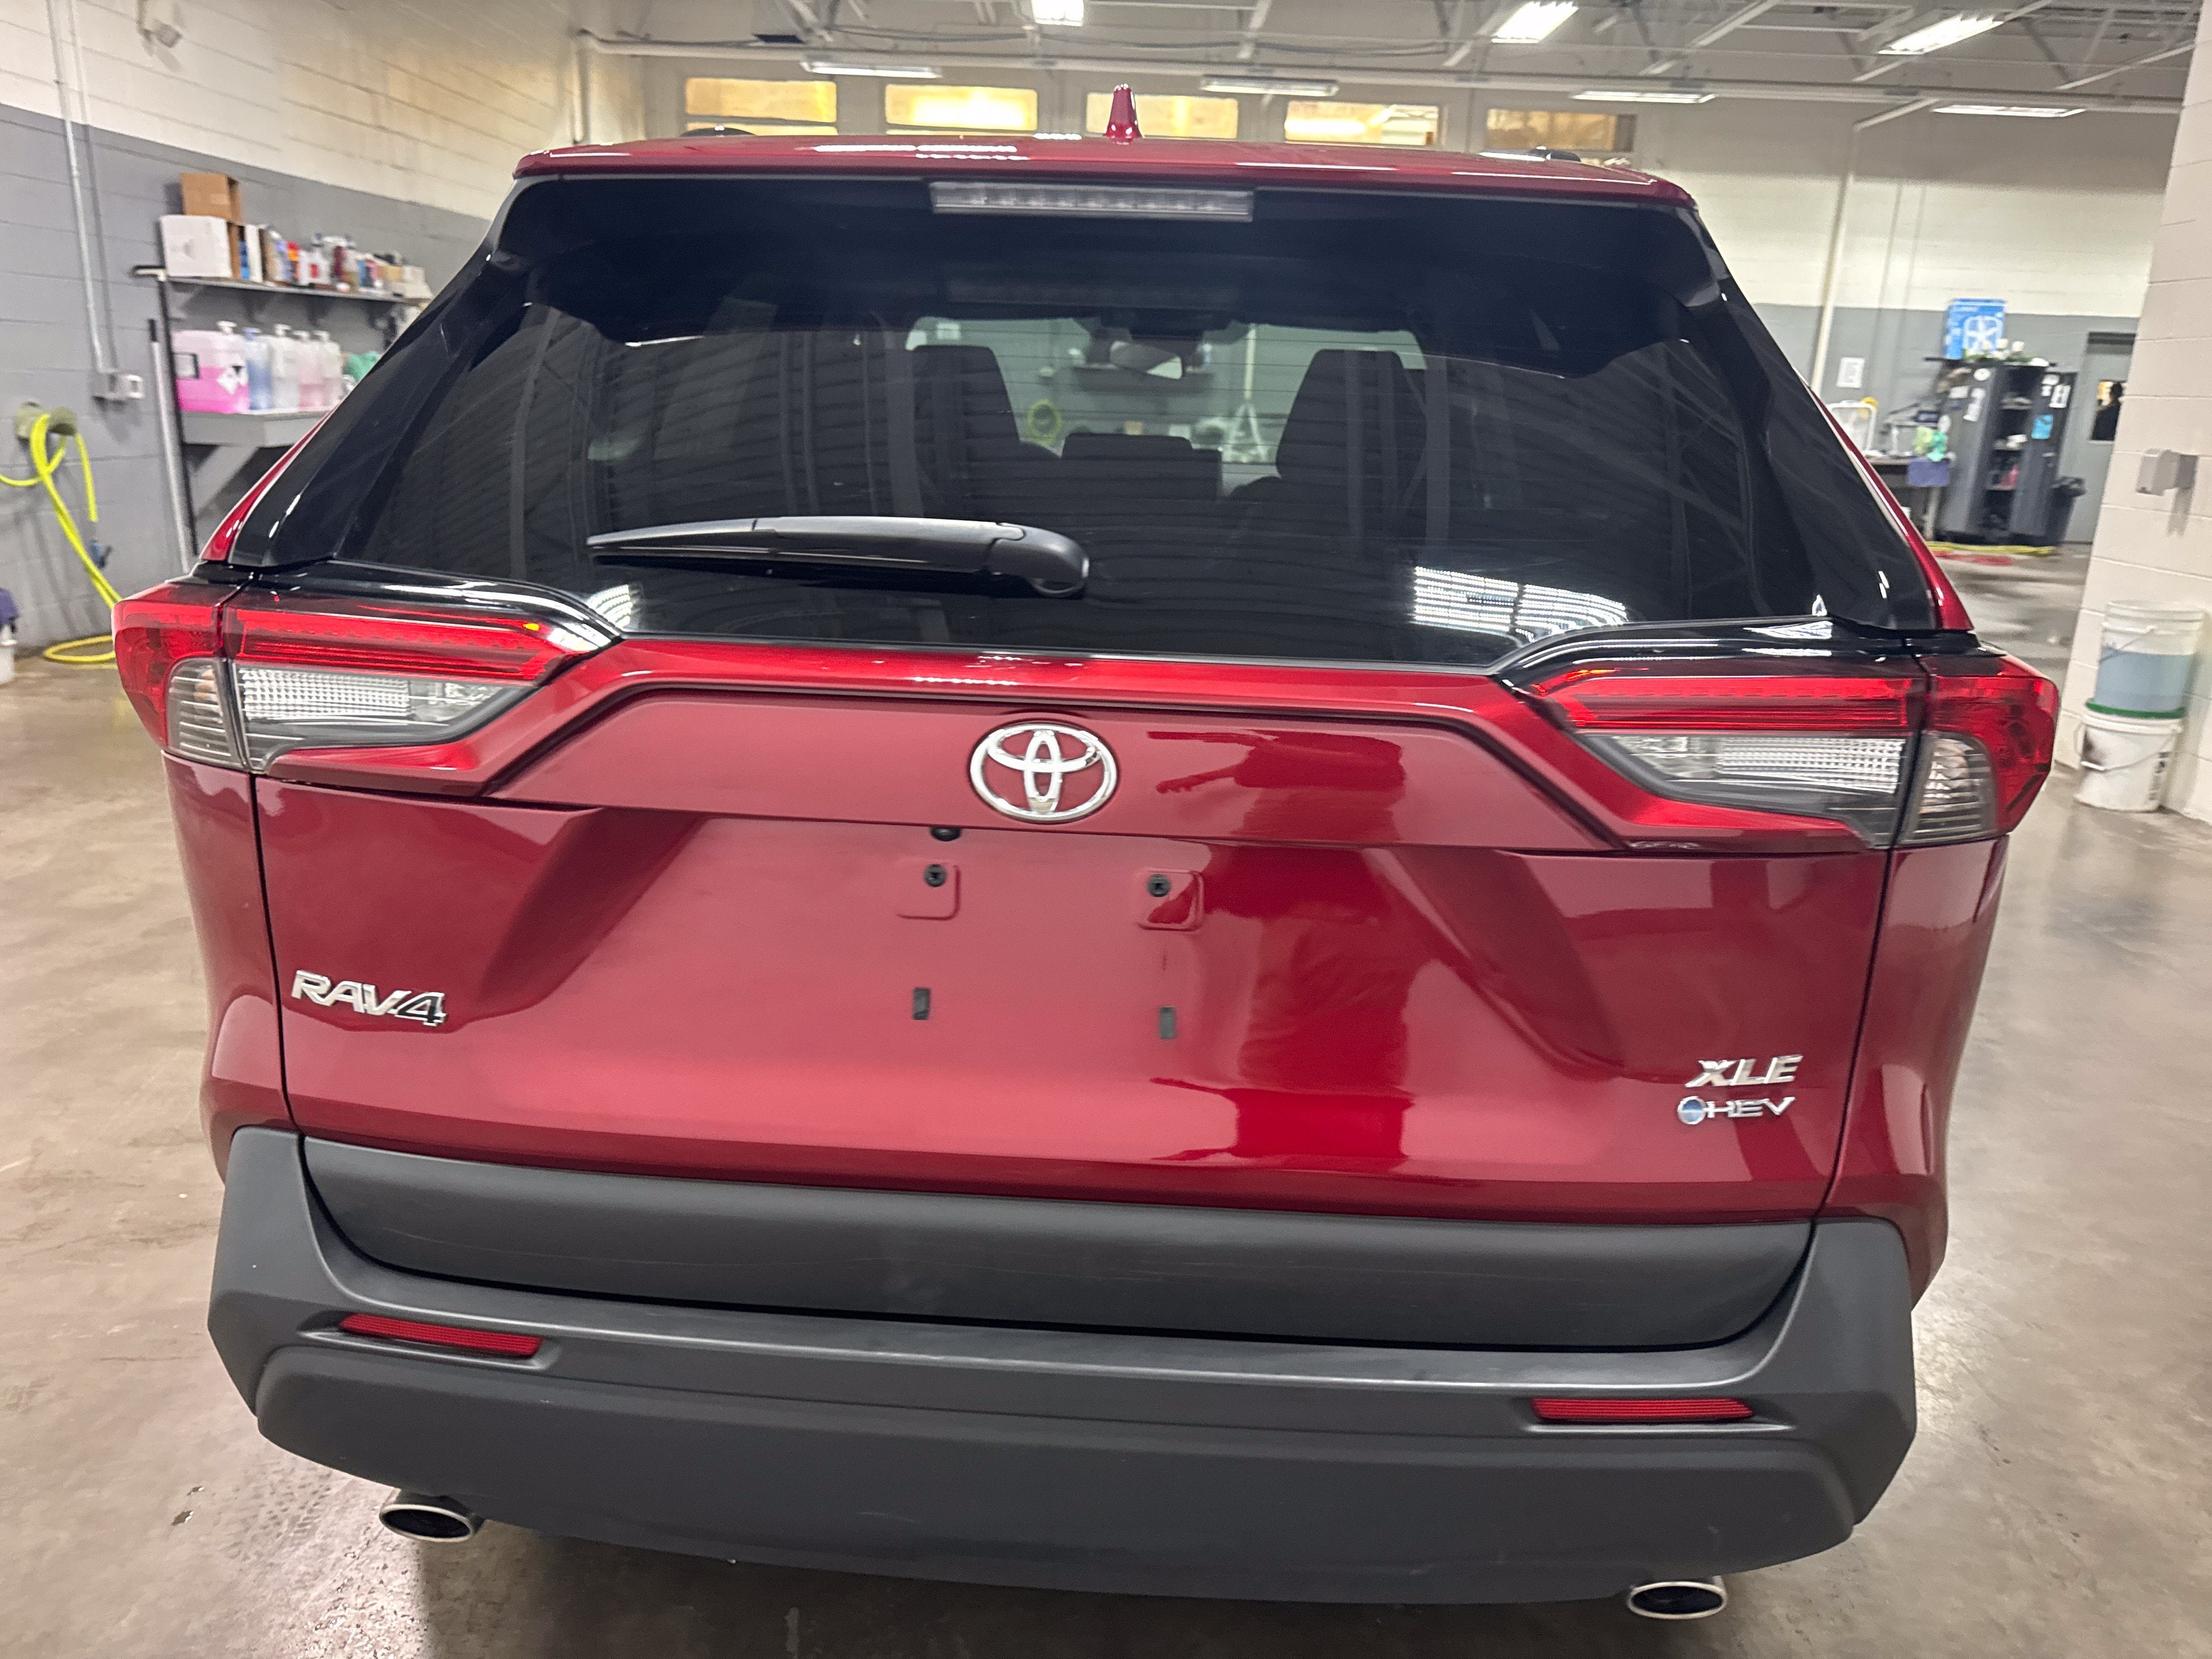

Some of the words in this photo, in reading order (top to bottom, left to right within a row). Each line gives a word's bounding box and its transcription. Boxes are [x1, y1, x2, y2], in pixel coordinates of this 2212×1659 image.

[291, 970, 447, 1026] RAV4
[1685, 1054, 1804, 1088] XLE
[1702, 1097, 1796, 1118] HEV
